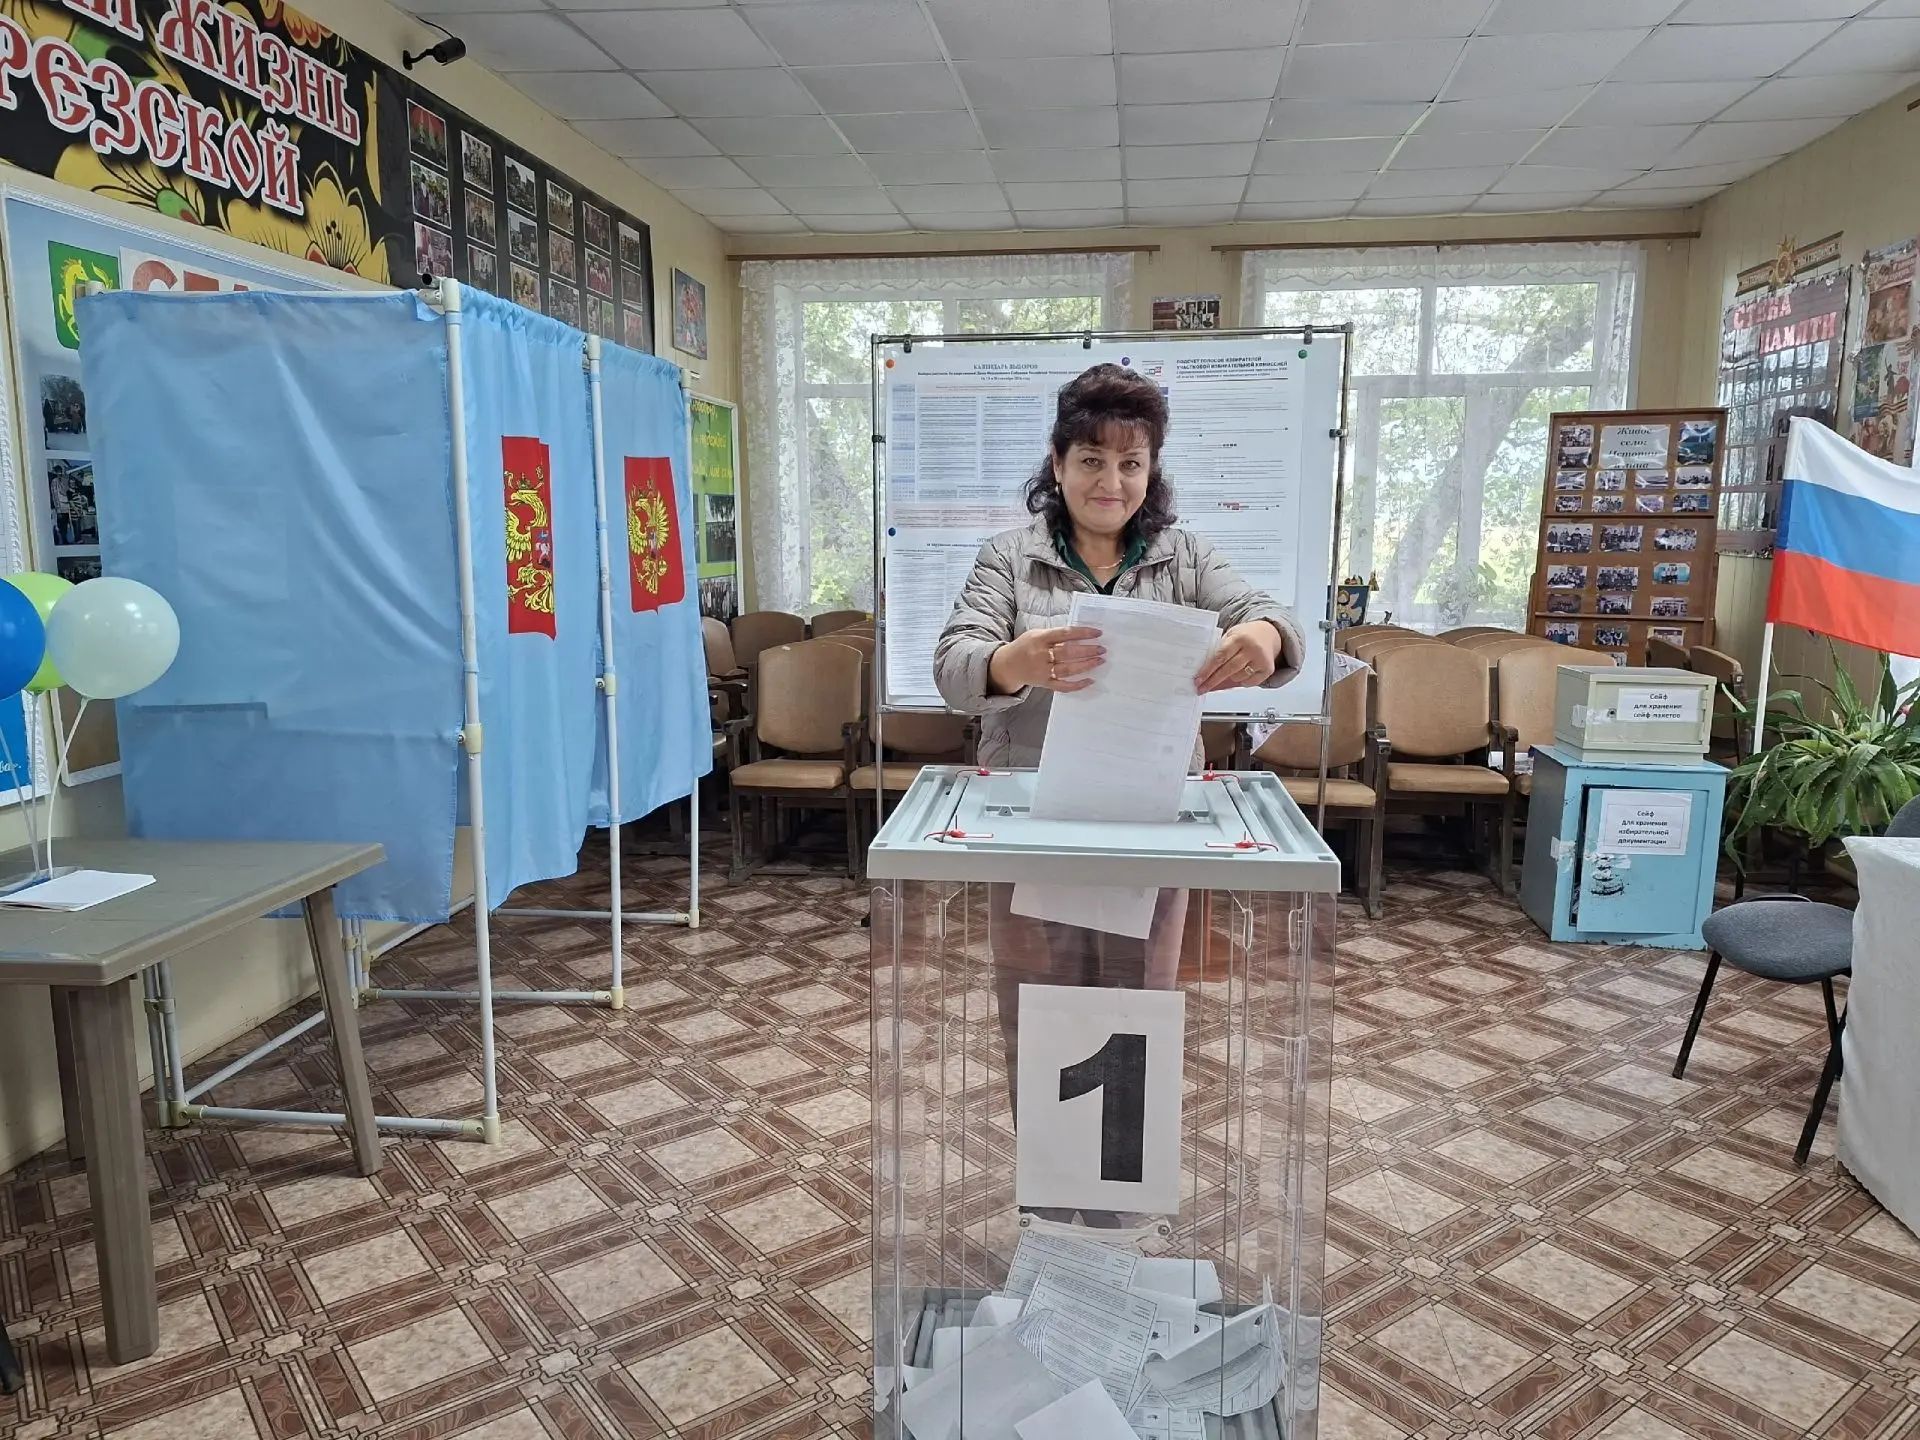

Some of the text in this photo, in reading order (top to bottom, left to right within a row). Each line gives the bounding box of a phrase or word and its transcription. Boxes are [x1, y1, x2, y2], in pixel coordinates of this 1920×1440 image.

[157, 0, 361, 146] ЖИЗНЬ
[1649, 693, 1668, 701] Сейф
[1637, 810, 1655, 818] Сейф
[1618, 828, 1669, 836] избирательной
[1058, 1033, 1147, 1183] 1
